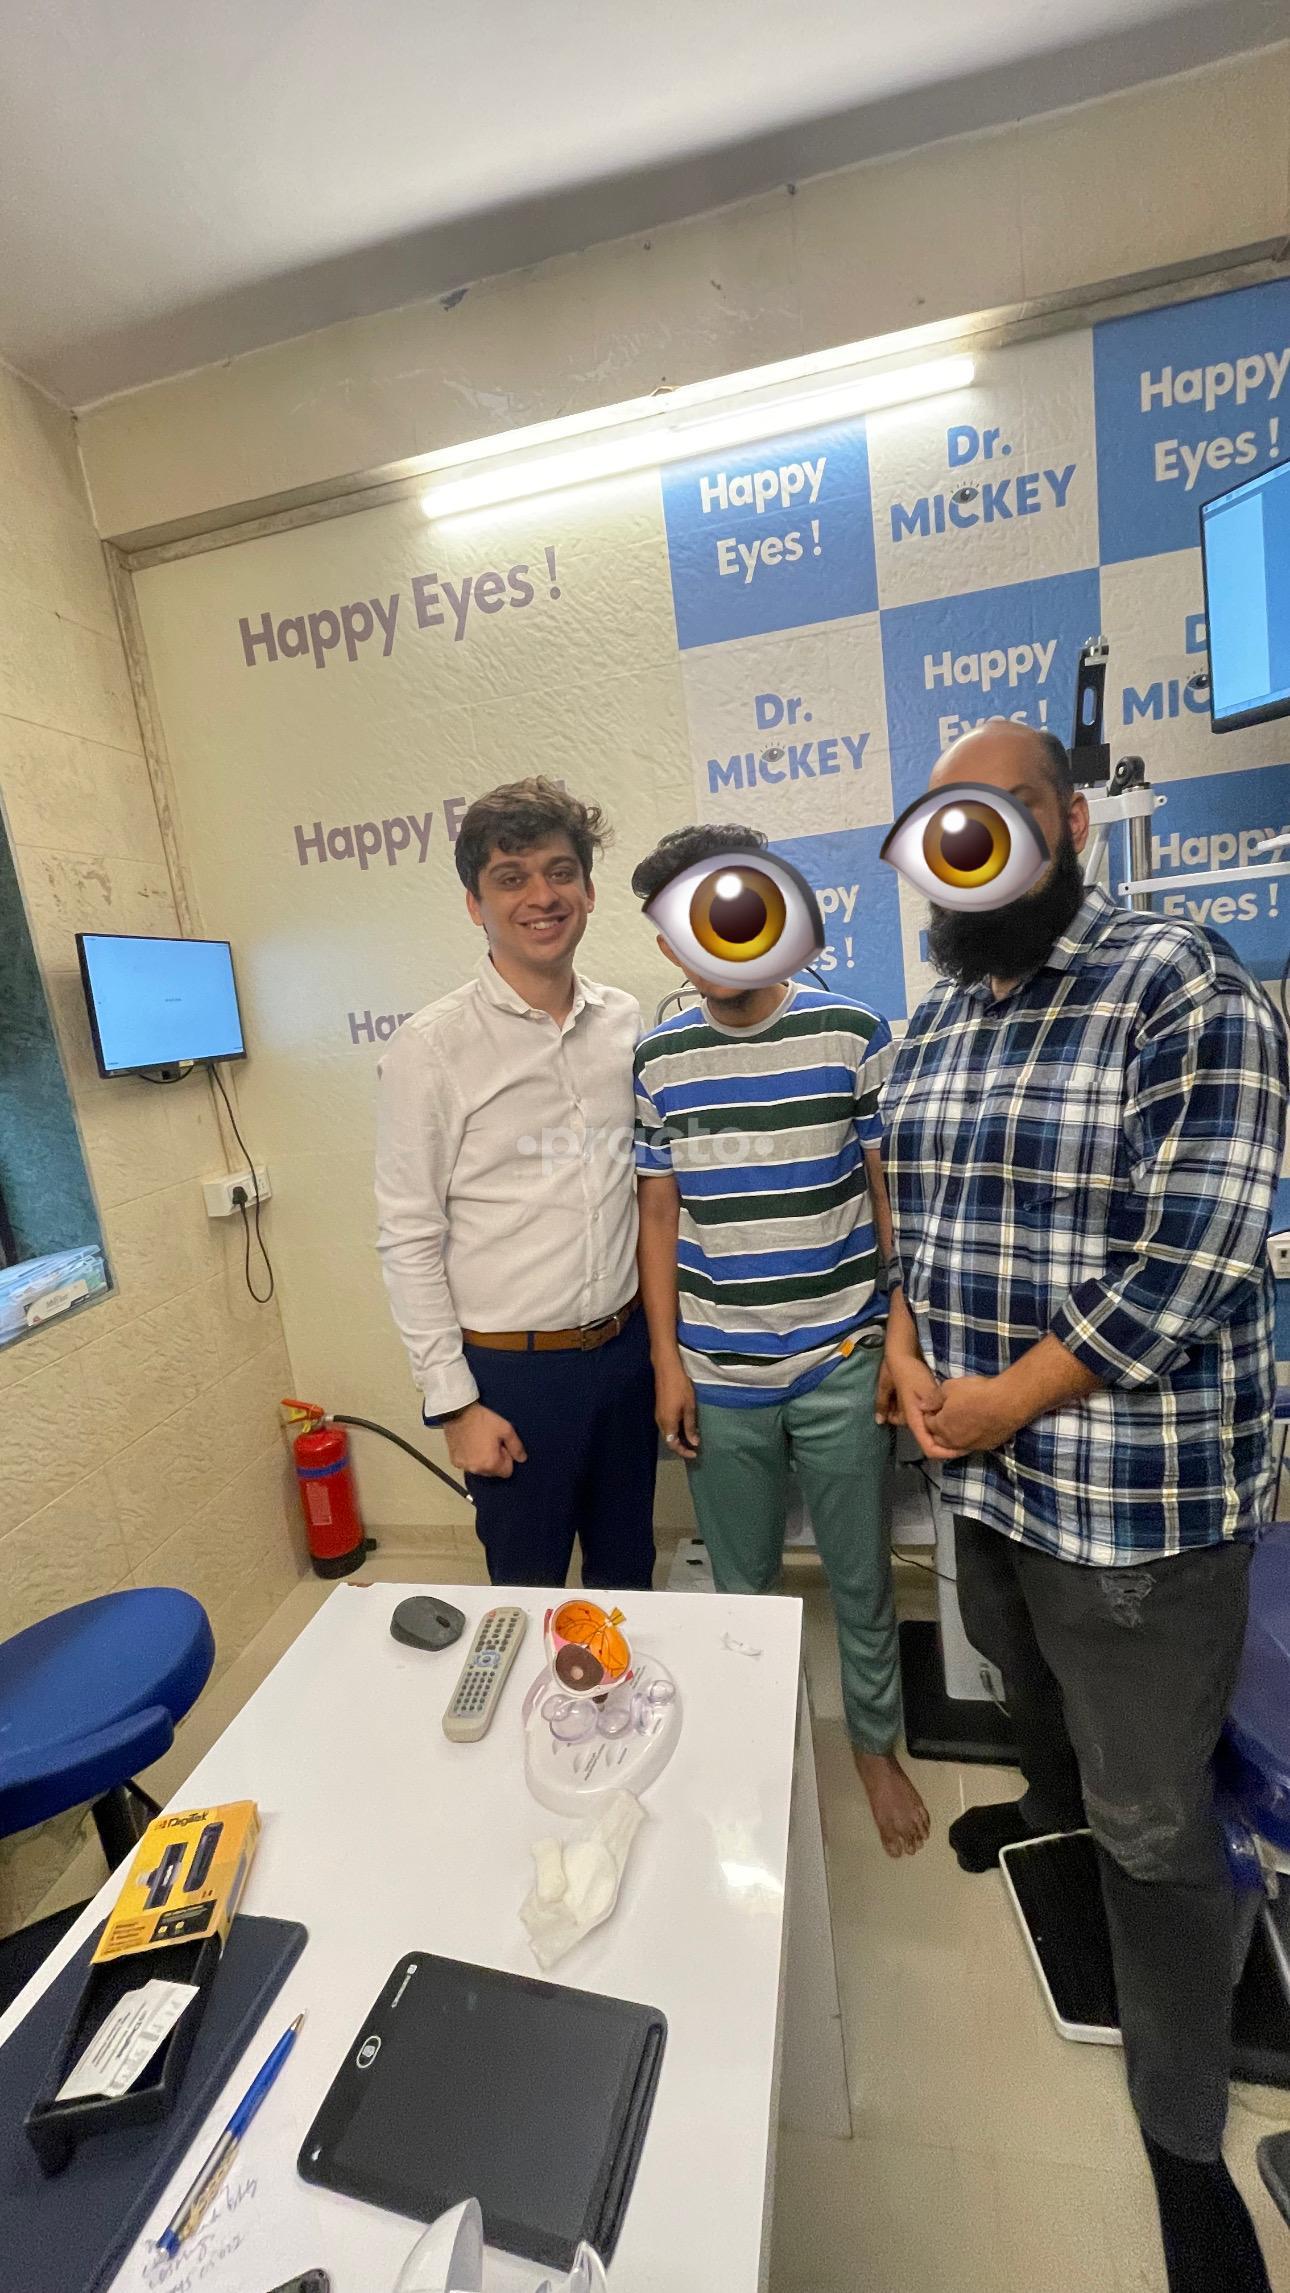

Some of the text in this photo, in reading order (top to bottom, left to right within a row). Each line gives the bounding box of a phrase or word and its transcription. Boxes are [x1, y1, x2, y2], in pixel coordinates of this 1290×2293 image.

[1140, 347, 1290, 413] Happy
[947, 424, 1012, 468] Dr.
[700, 457, 827, 515] Happy
[890, 464, 1077, 543] MICKEY
[239, 593, 400, 669] Happy
[924, 640, 1057, 692] Happy
[754, 693, 813, 730] Dr.
[1122, 677, 1211, 726] MIC
[706, 732, 871, 794] MICKEY
[294, 812, 433, 871] Happy
